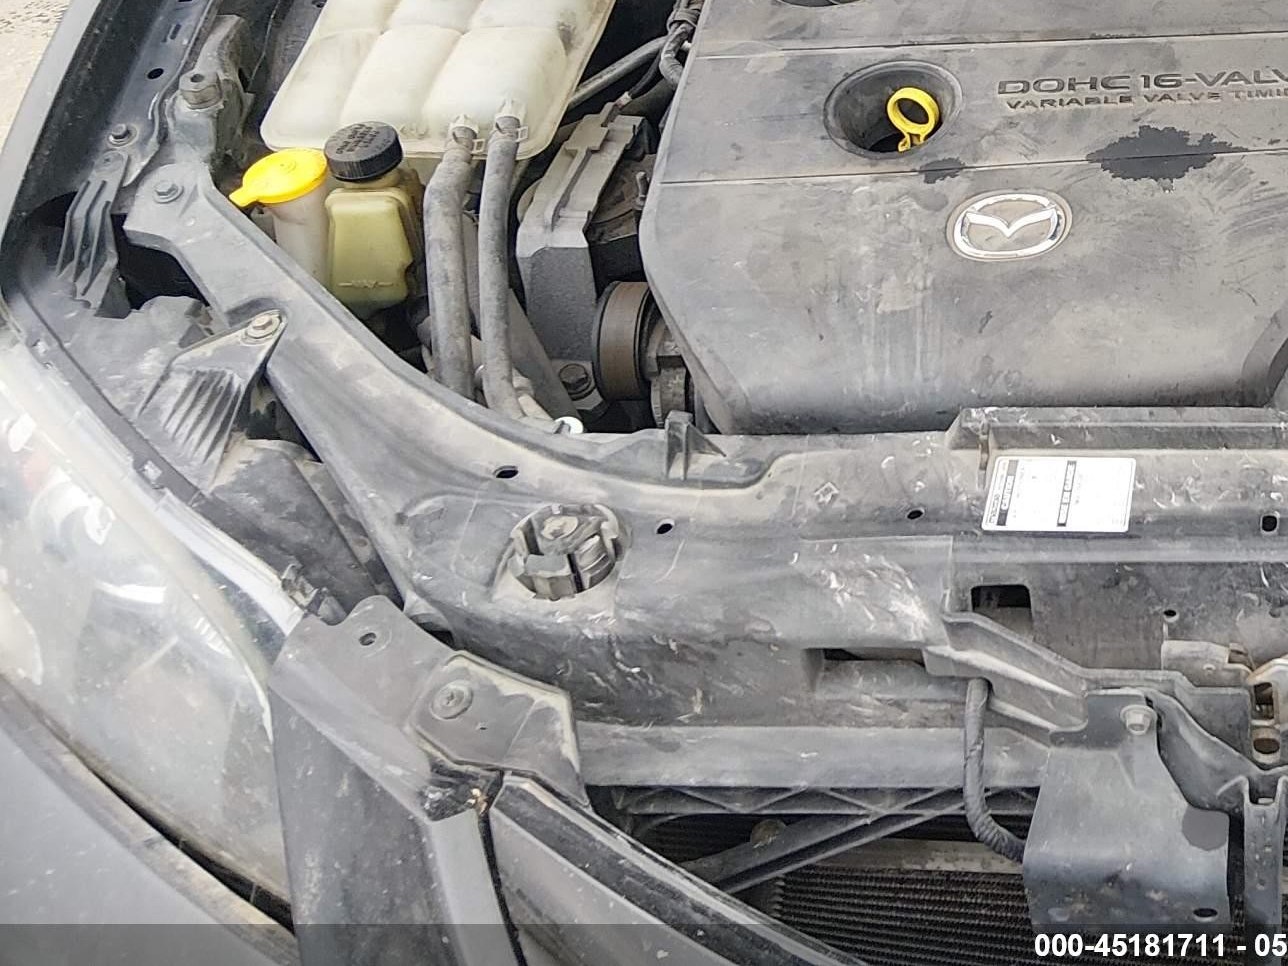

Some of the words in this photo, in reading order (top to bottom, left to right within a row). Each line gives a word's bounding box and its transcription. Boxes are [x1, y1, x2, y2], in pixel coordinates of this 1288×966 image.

[997, 74, 1131, 96] DOHC
[1006, 94, 1133, 110] VARIABLE
[1143, 90, 1221, 104] VALVE
